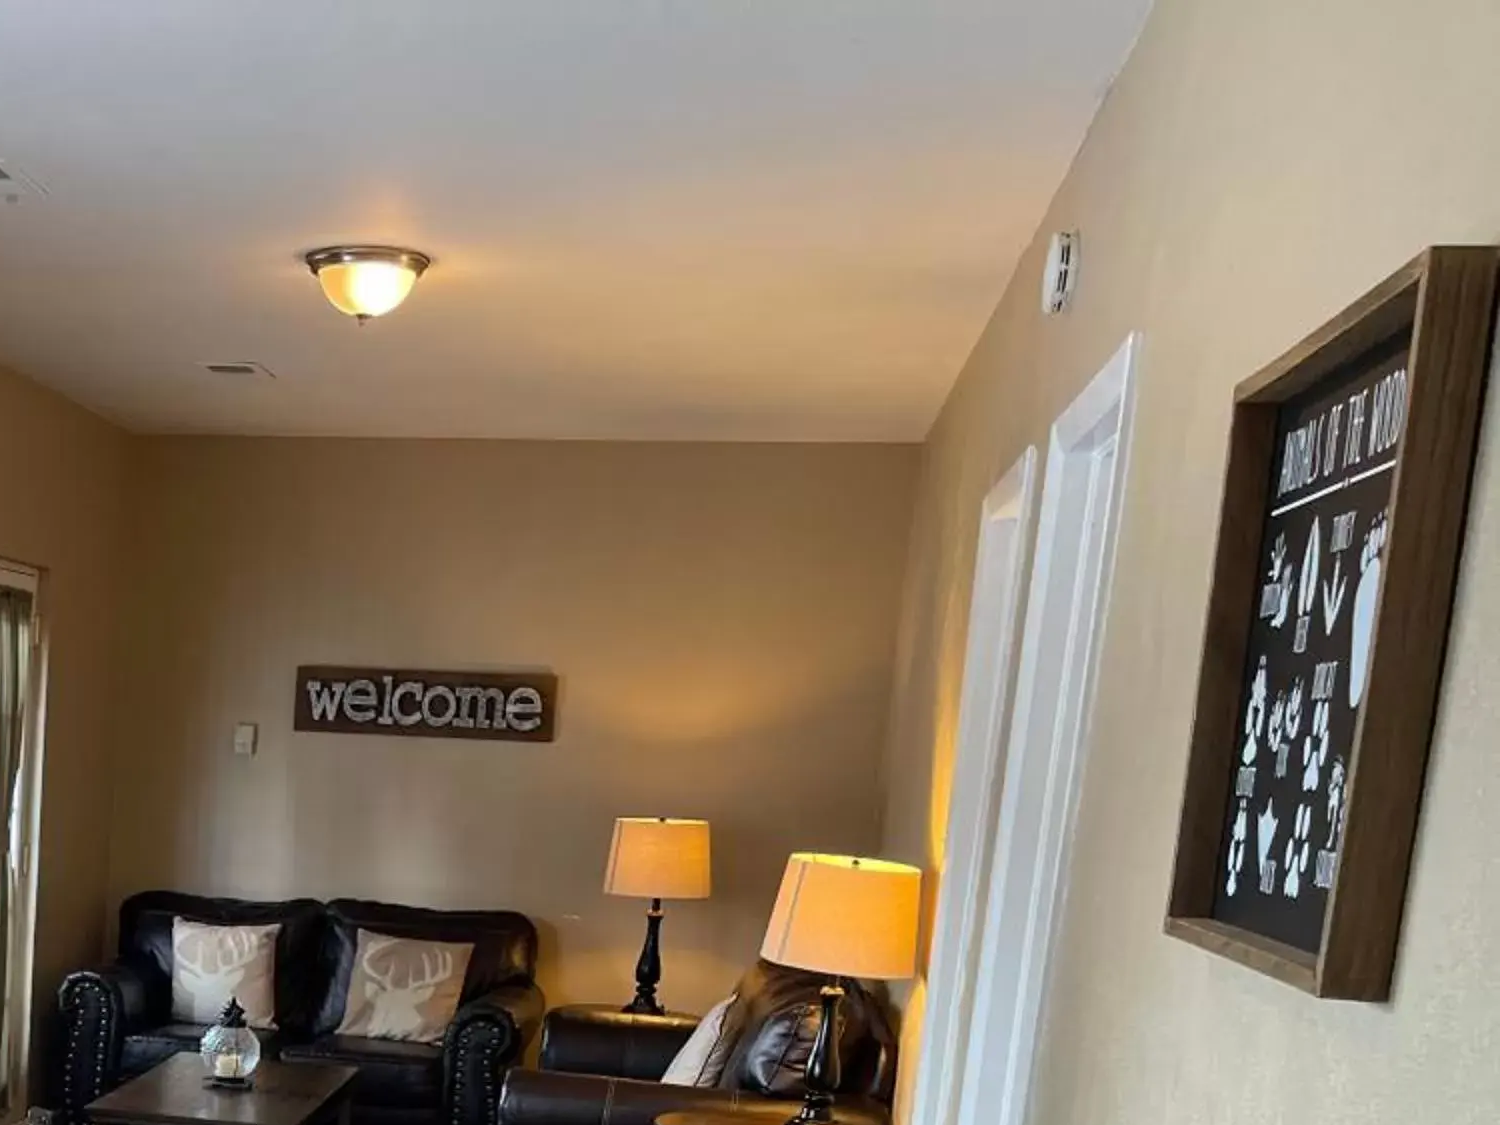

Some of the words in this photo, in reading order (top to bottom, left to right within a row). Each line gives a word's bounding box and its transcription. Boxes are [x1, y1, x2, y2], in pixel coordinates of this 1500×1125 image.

[1323, 403, 1344, 477] OF
[1342, 387, 1369, 471] THE
[306, 675, 542, 732] welcome
